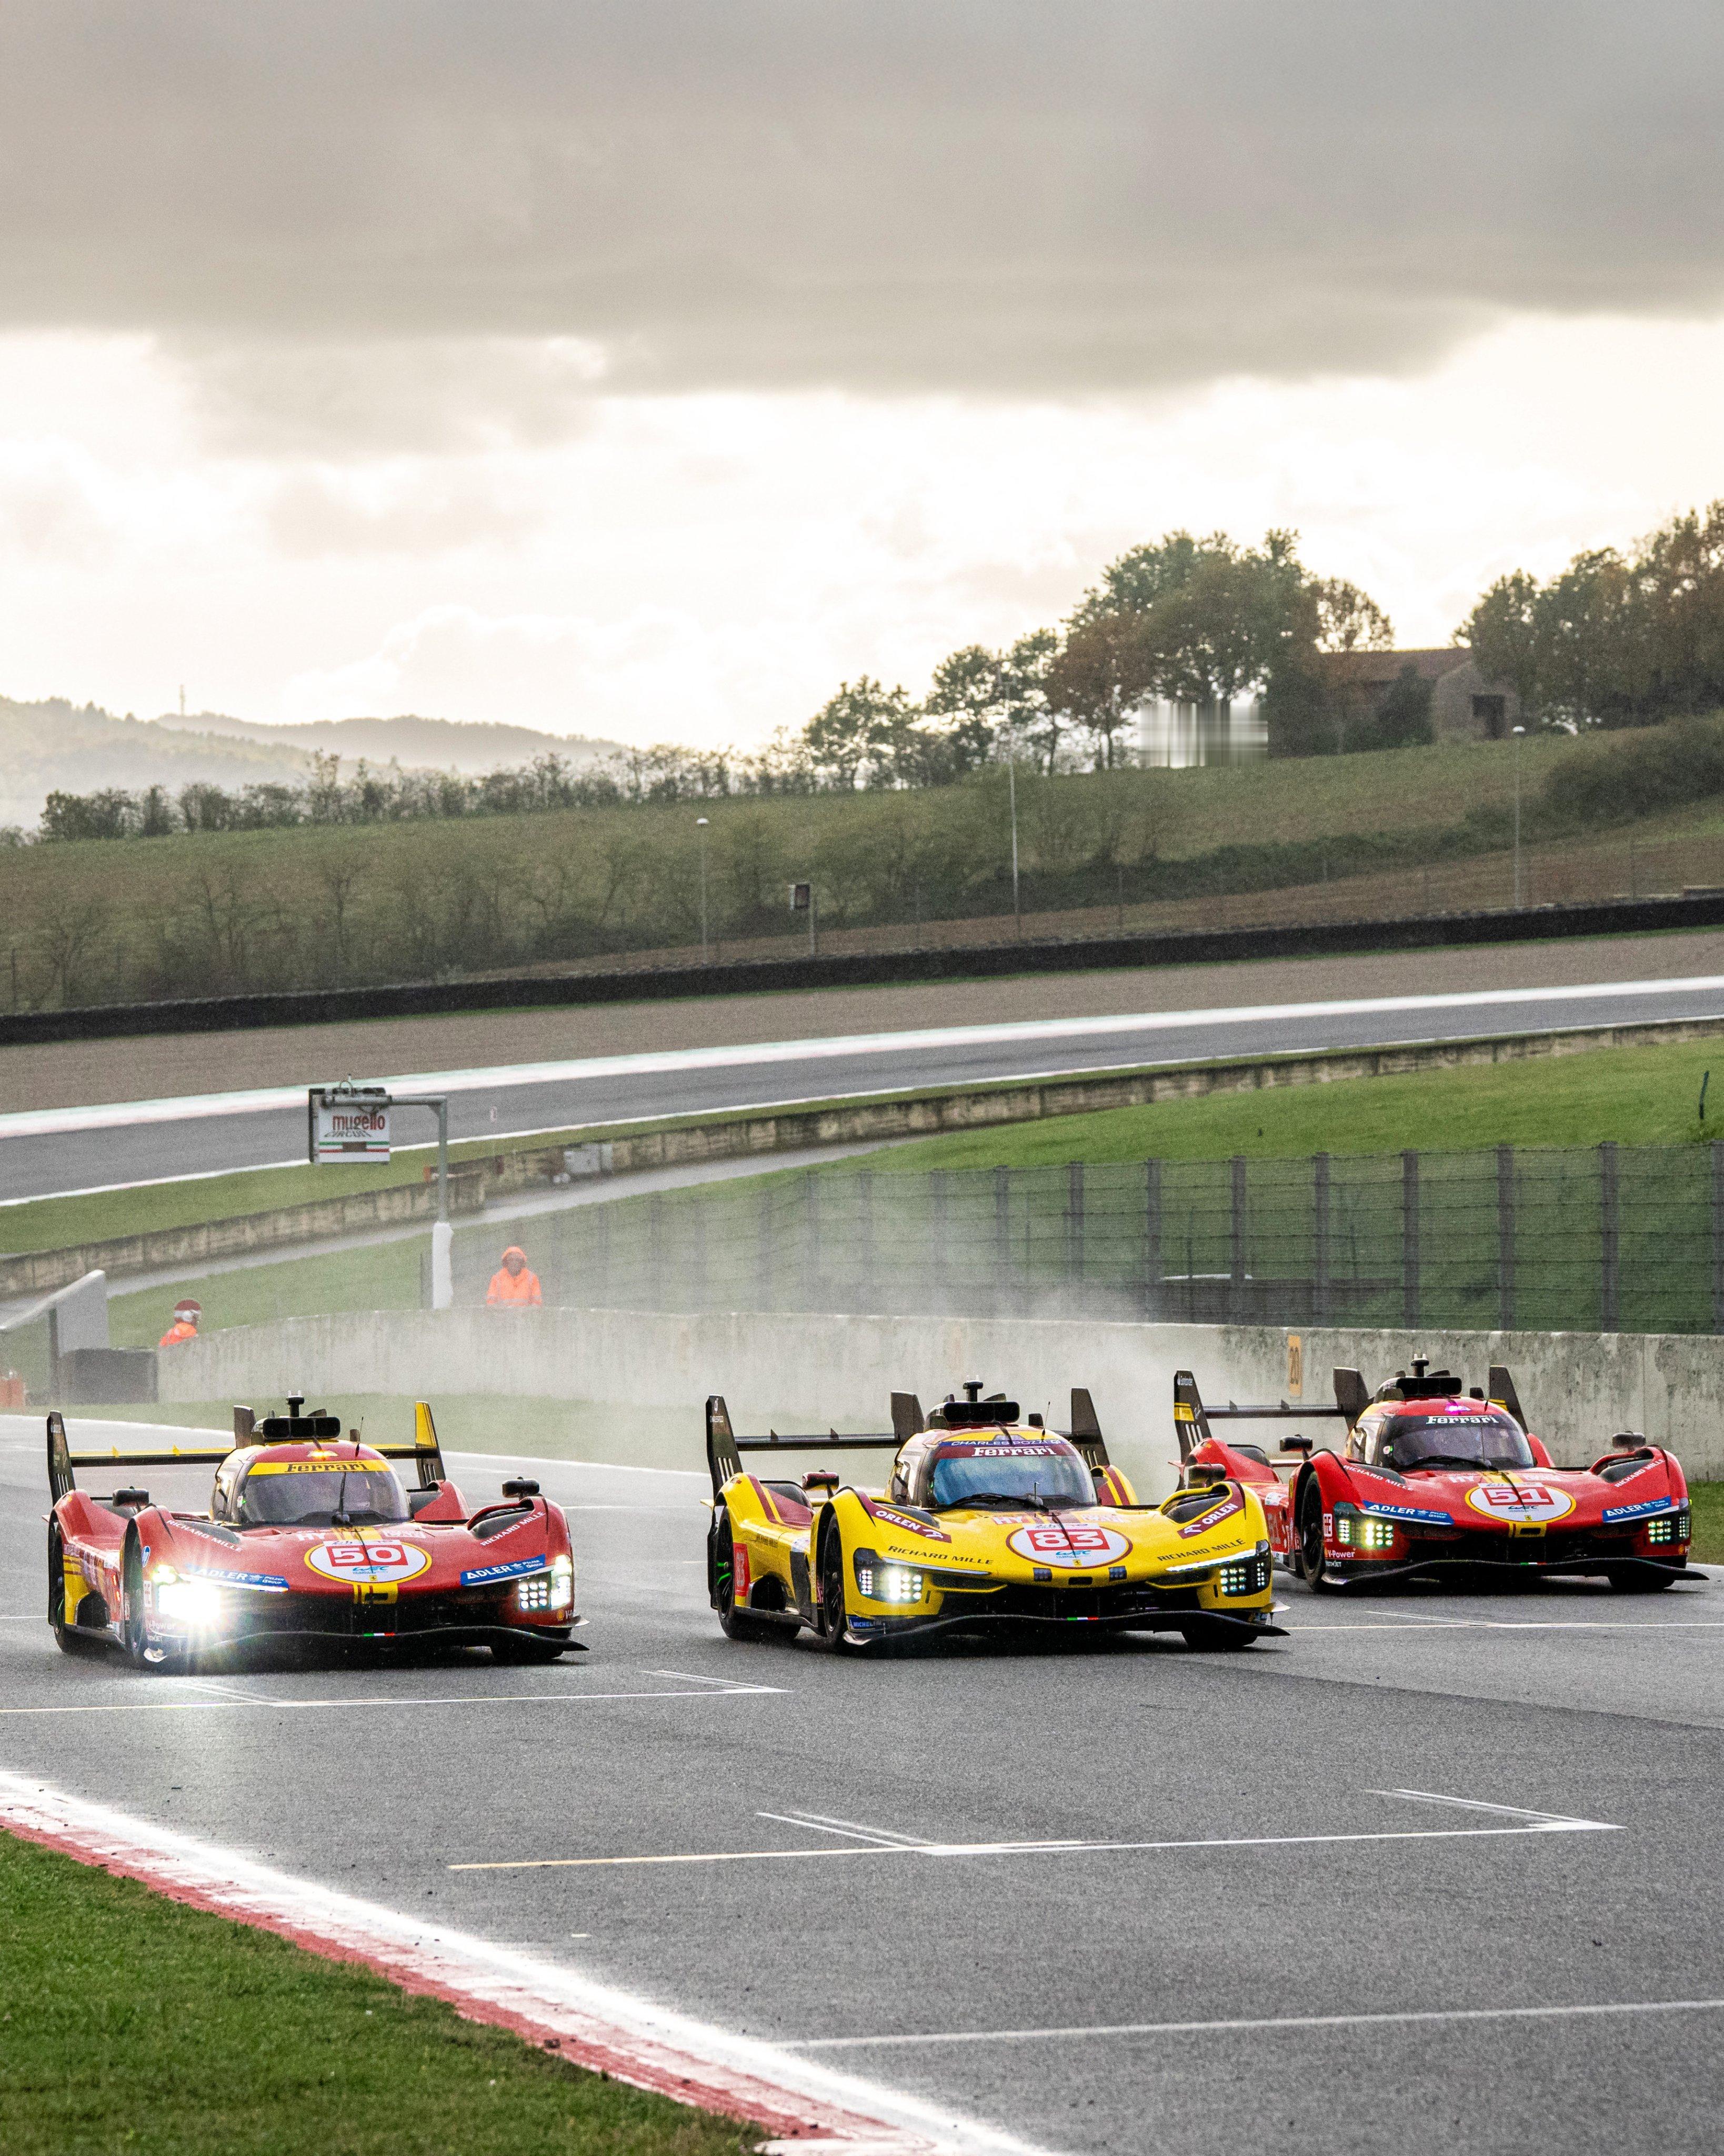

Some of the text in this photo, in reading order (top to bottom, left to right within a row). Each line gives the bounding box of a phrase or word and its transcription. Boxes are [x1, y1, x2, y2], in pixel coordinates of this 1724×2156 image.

[333, 1112, 385, 1130] mugello
[1426, 1415, 1499, 1424] Ferrari
[971, 1446, 1057, 1456] Ferrari
[285, 1462, 368, 1473] Ferrari
[1343, 1465, 1384, 1480] RICHARD
[1615, 1458, 1666, 1488] RICHARD MILLE
[1487, 1489, 1550, 1503] 51
[1202, 1503, 1239, 1524] ORLEN
[1368, 1504, 1416, 1515] ADLER
[1606, 1504, 1645, 1517] ADLER
[876, 1510, 921, 1531] ORLEN
[994, 1516, 1024, 1524] HY
[166, 1520, 243, 1552] RICHARD MILLE
[480, 1511, 546, 1546] RICHARD MILLE
[296, 1532, 327, 1541] HY
[1034, 1531, 1104, 1548] 83
[332, 1546, 402, 1564] 50
[888, 1545, 994, 1565] RICHARD MILLE
[1157, 1538, 1246, 1561] RICHARD MILLE
[194, 1569, 249, 1581] ADLER
[467, 1565, 513, 1580] ADLER
